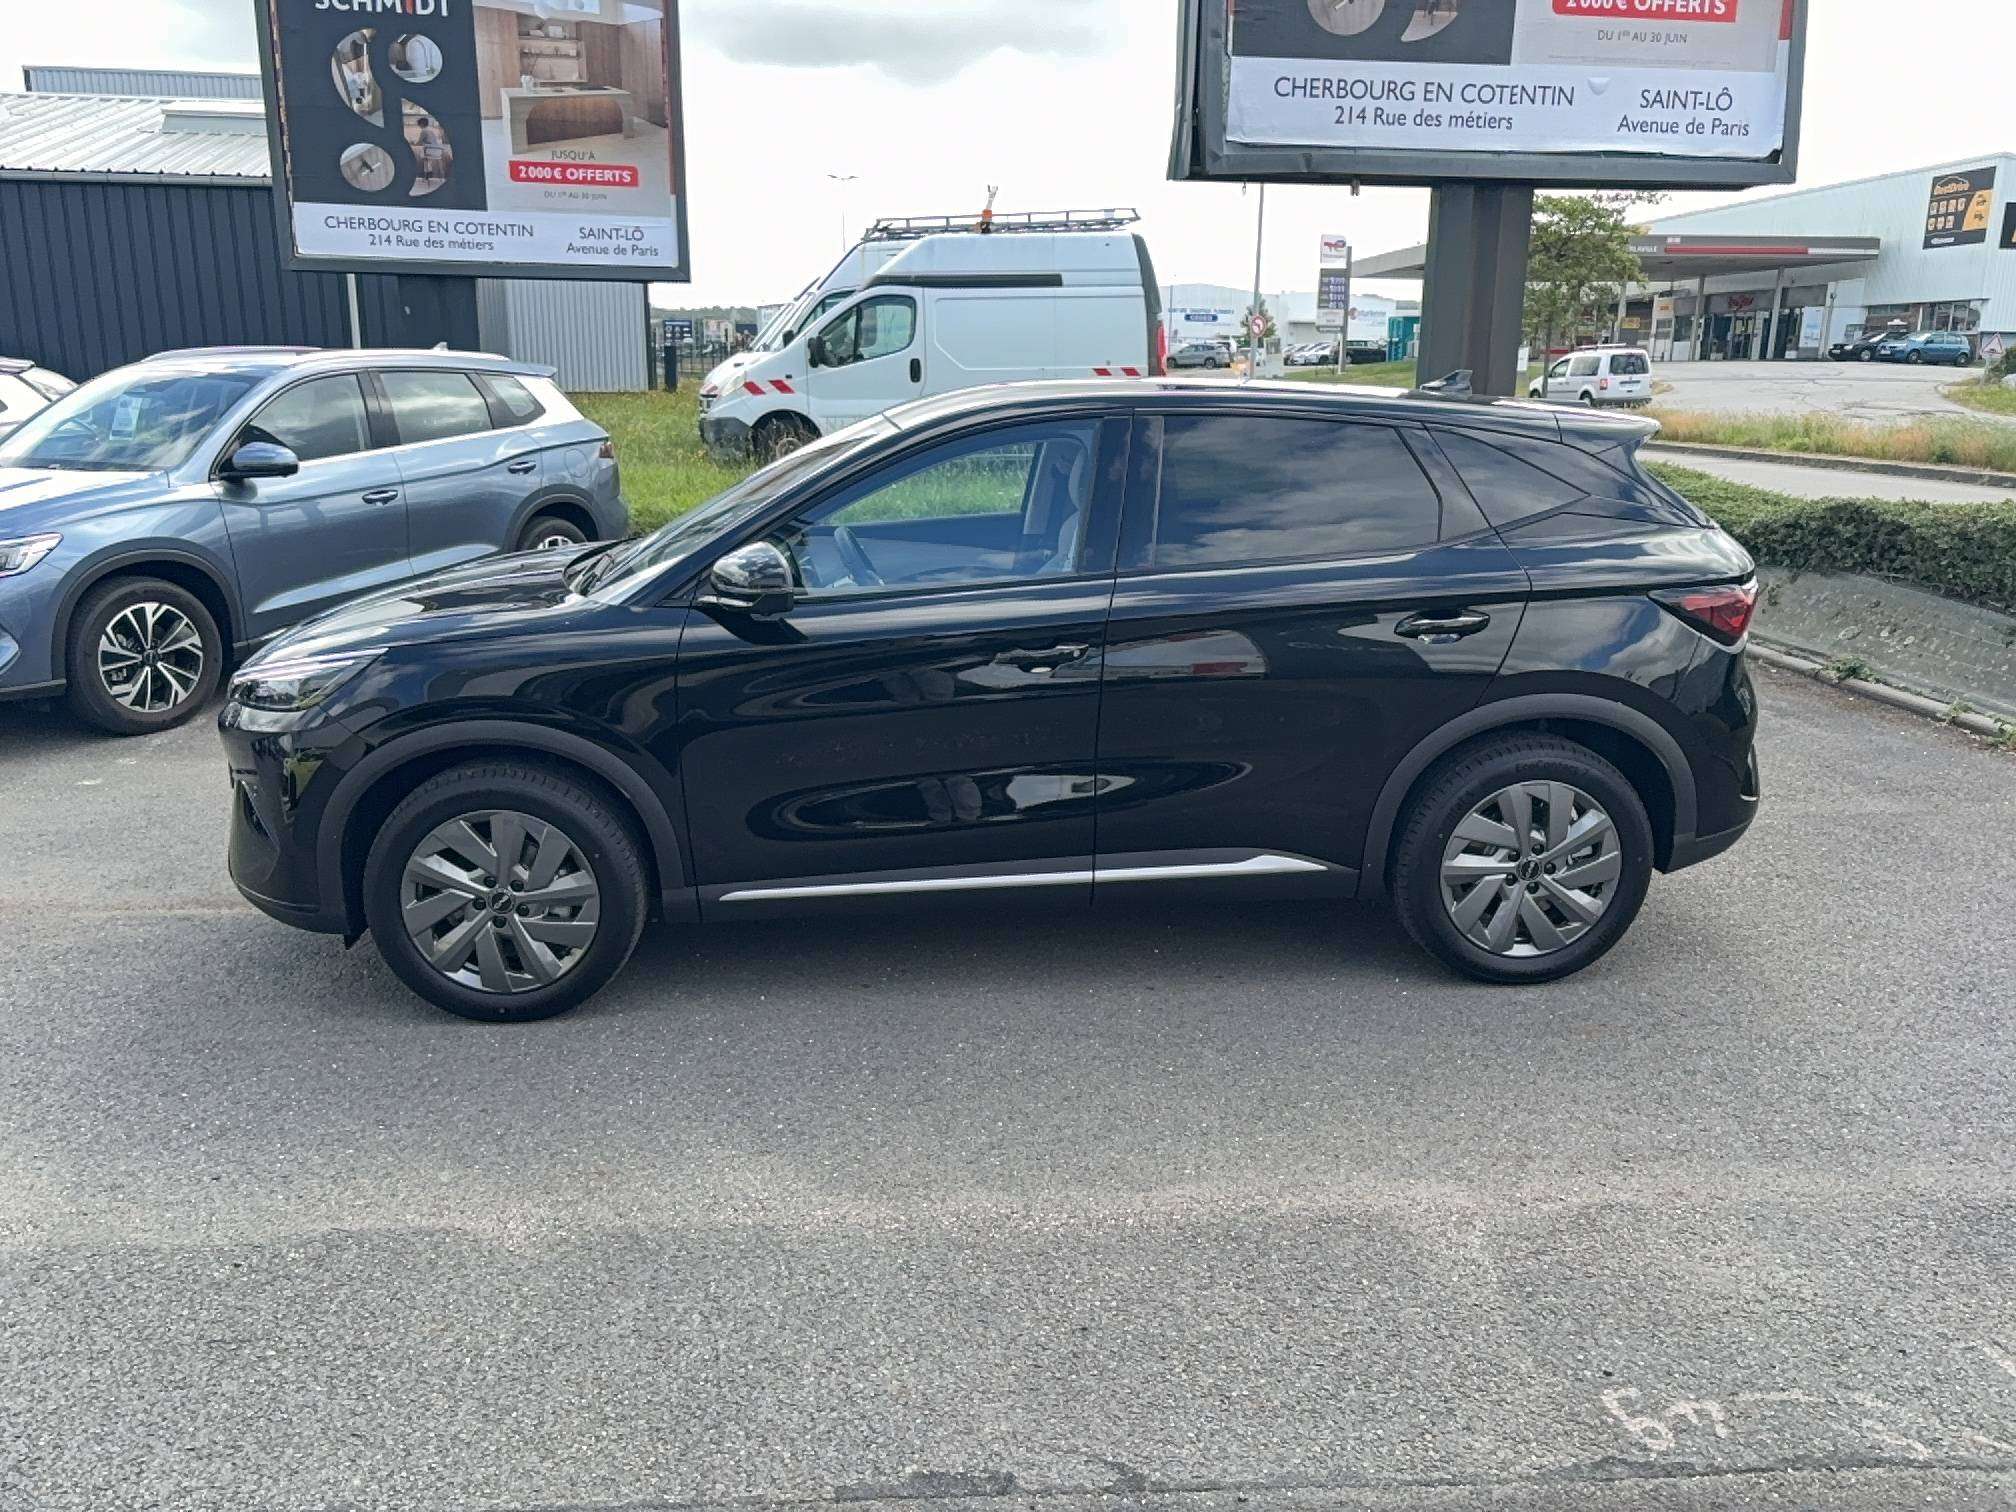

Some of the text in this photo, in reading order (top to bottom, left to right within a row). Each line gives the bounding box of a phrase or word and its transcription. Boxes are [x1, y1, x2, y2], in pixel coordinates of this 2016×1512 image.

[1634, 0, 1726, 15] OFFERTS
[1597, 30, 1614, 41] DU
[1632, 32, 1647, 42] AU
[1650, 32, 1662, 42] 30
[1663, 32, 1688, 45] JUIN
[1274, 76, 1575, 106] CHERBOURG EN COTENTIN
[1640, 86, 1733, 111] SAINT-LÔ
[1334, 106, 1513, 130] 214 Rue des métiers
[1617, 114, 1750, 136] Avenue de Paris
[566, 167, 632, 183] OFFERTS
[324, 215, 534, 237] CHERBOURG EN COTENTIN
[579, 225, 645, 242] SAINT-LÔ
[369, 234, 494, 251] 214 Rue des métiers
[566, 242, 659, 257] Avenue de Paris
